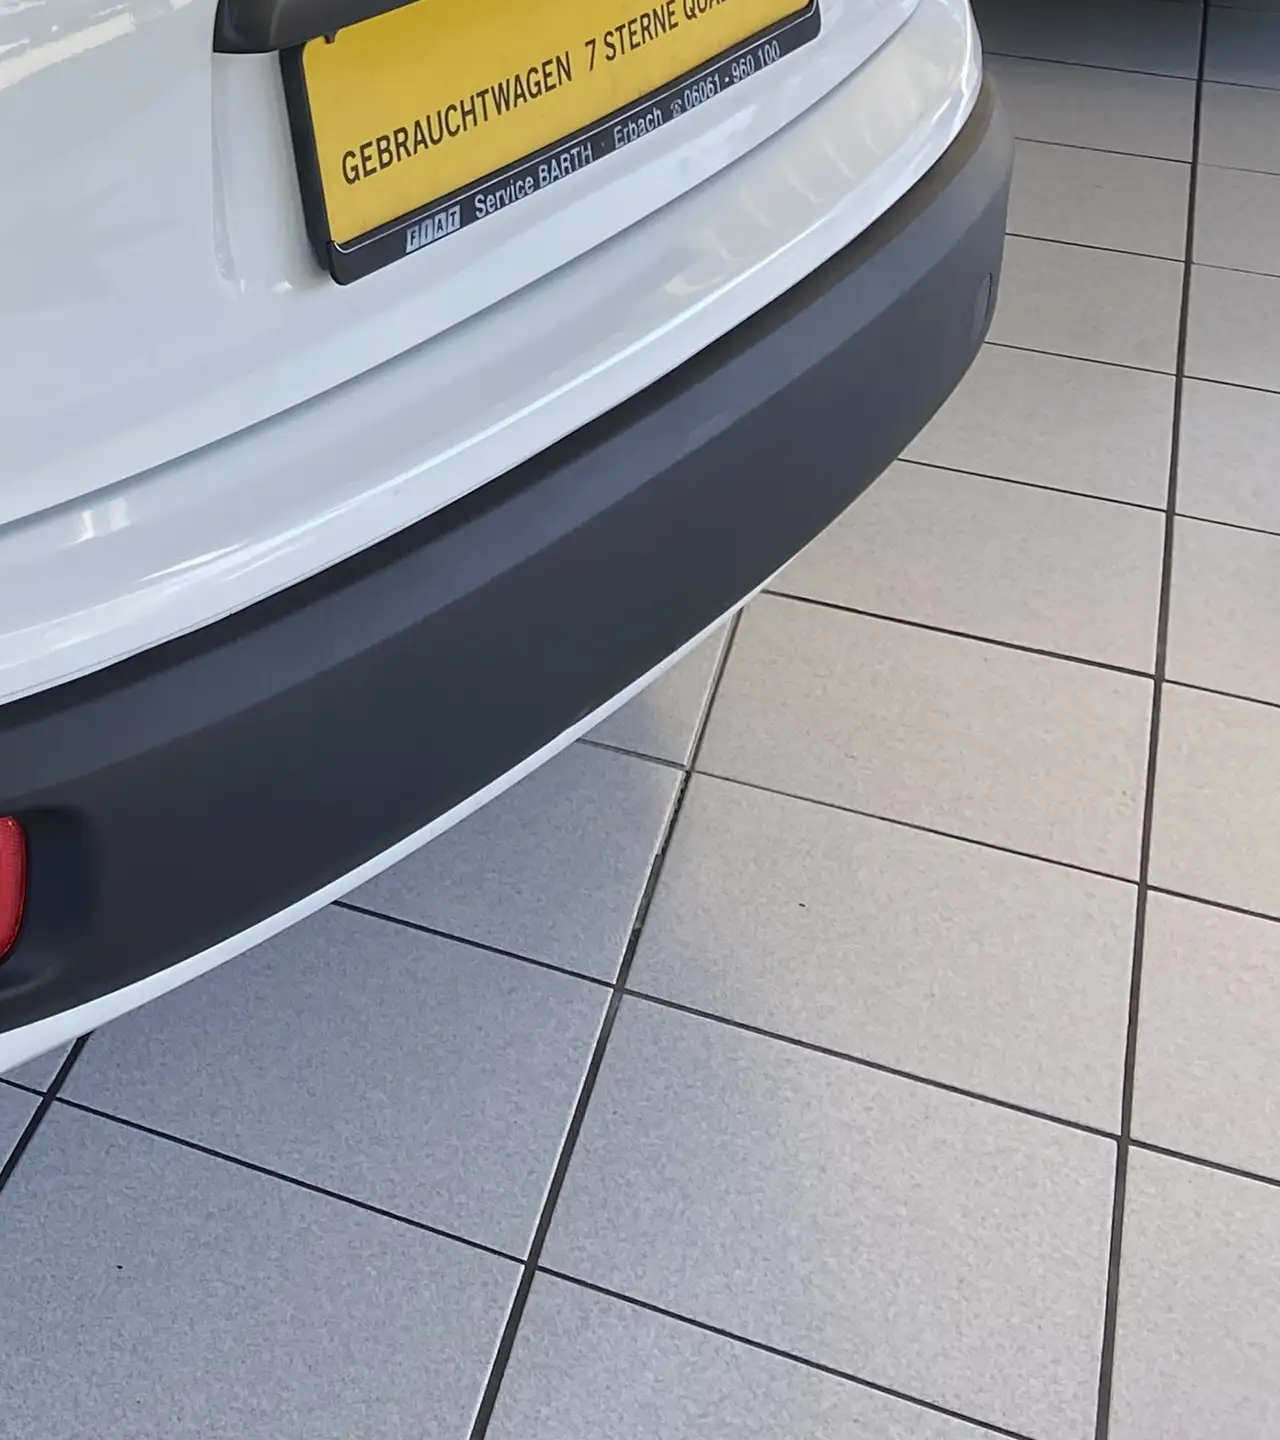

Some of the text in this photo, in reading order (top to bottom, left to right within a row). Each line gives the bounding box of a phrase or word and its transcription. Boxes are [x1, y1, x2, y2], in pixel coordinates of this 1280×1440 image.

[342, 51, 572, 185] GEBRAUCHTWAGEN
[584, 38, 597, 72] 7
[405, 205, 461, 253] FIAT
[474, 176, 535, 219] Service
[539, 142, 594, 187] BARTH
[613, 107, 664, 149] Erbach
[684, 73, 721, 111] 06061
[731, 54, 756, 84] 960
[757, 40, 781, 65] 100
